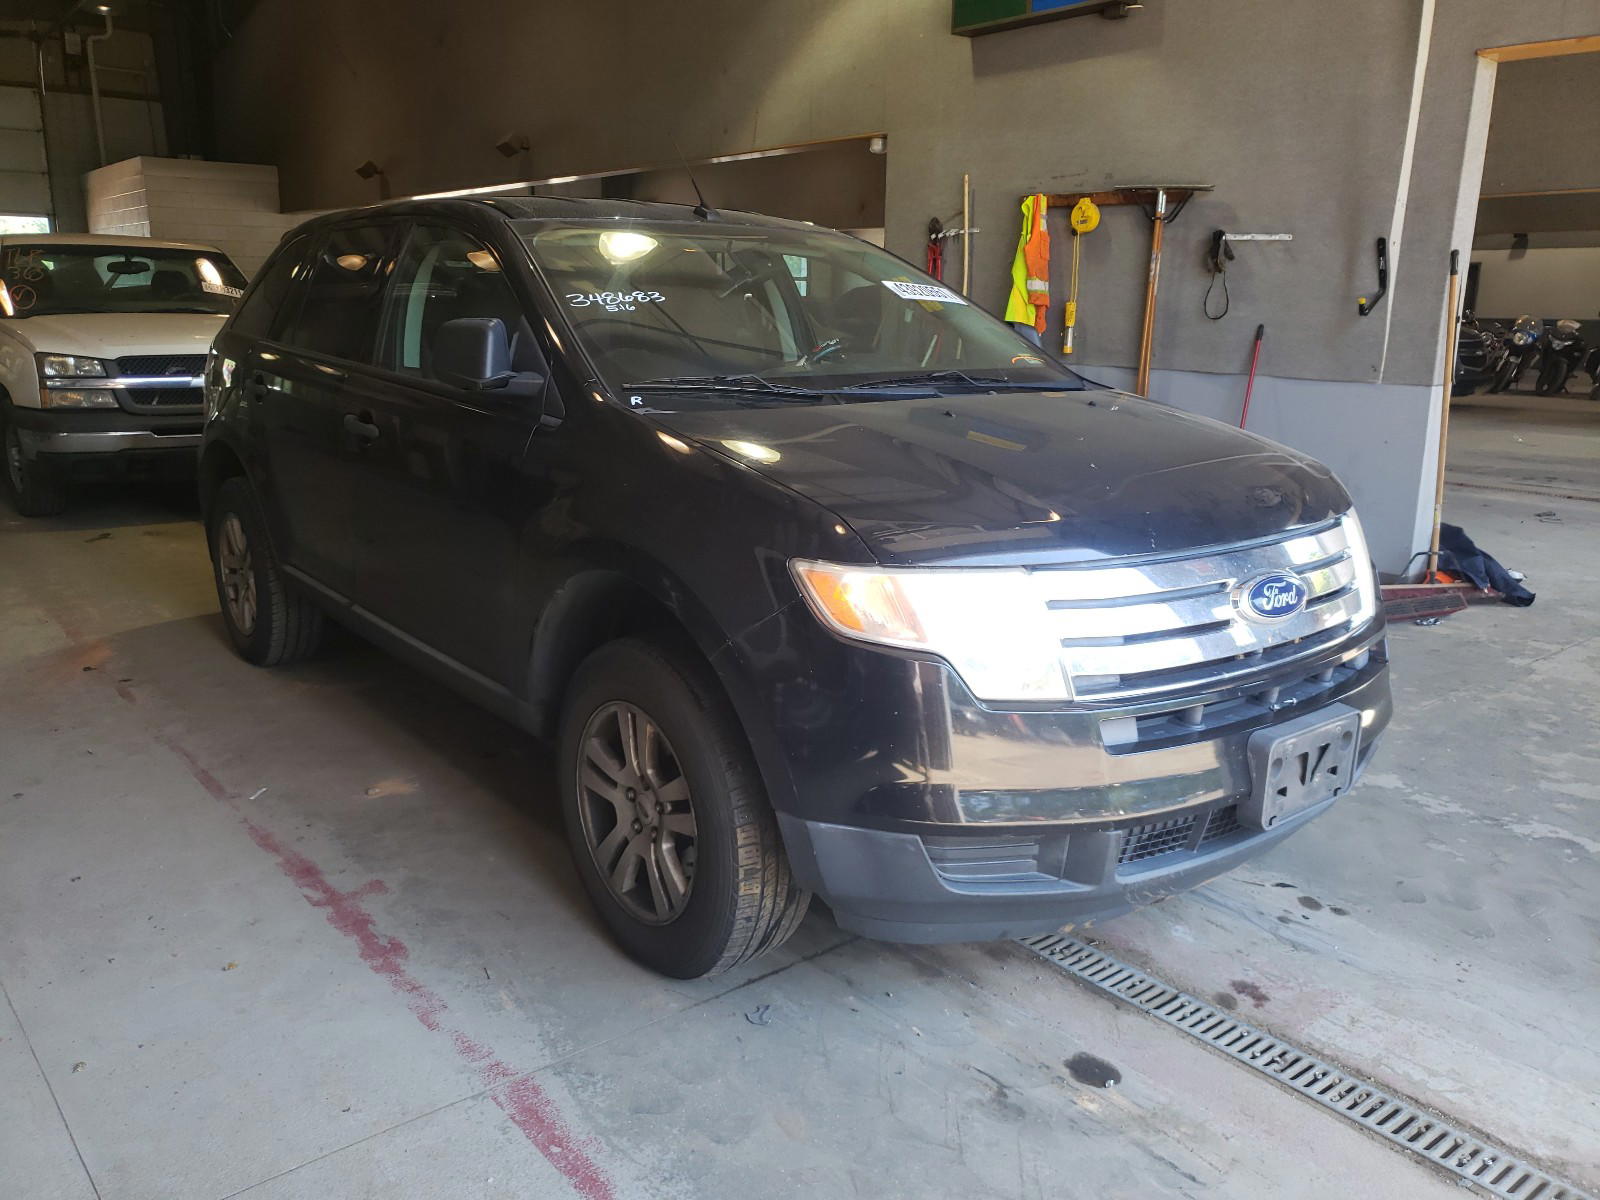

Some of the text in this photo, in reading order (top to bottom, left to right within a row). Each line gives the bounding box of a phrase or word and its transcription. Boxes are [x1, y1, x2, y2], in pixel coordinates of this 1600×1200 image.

[565, 290, 666, 307] 348683
[630, 395, 643, 406] R
[1262, 581, 1298, 610] Ford
